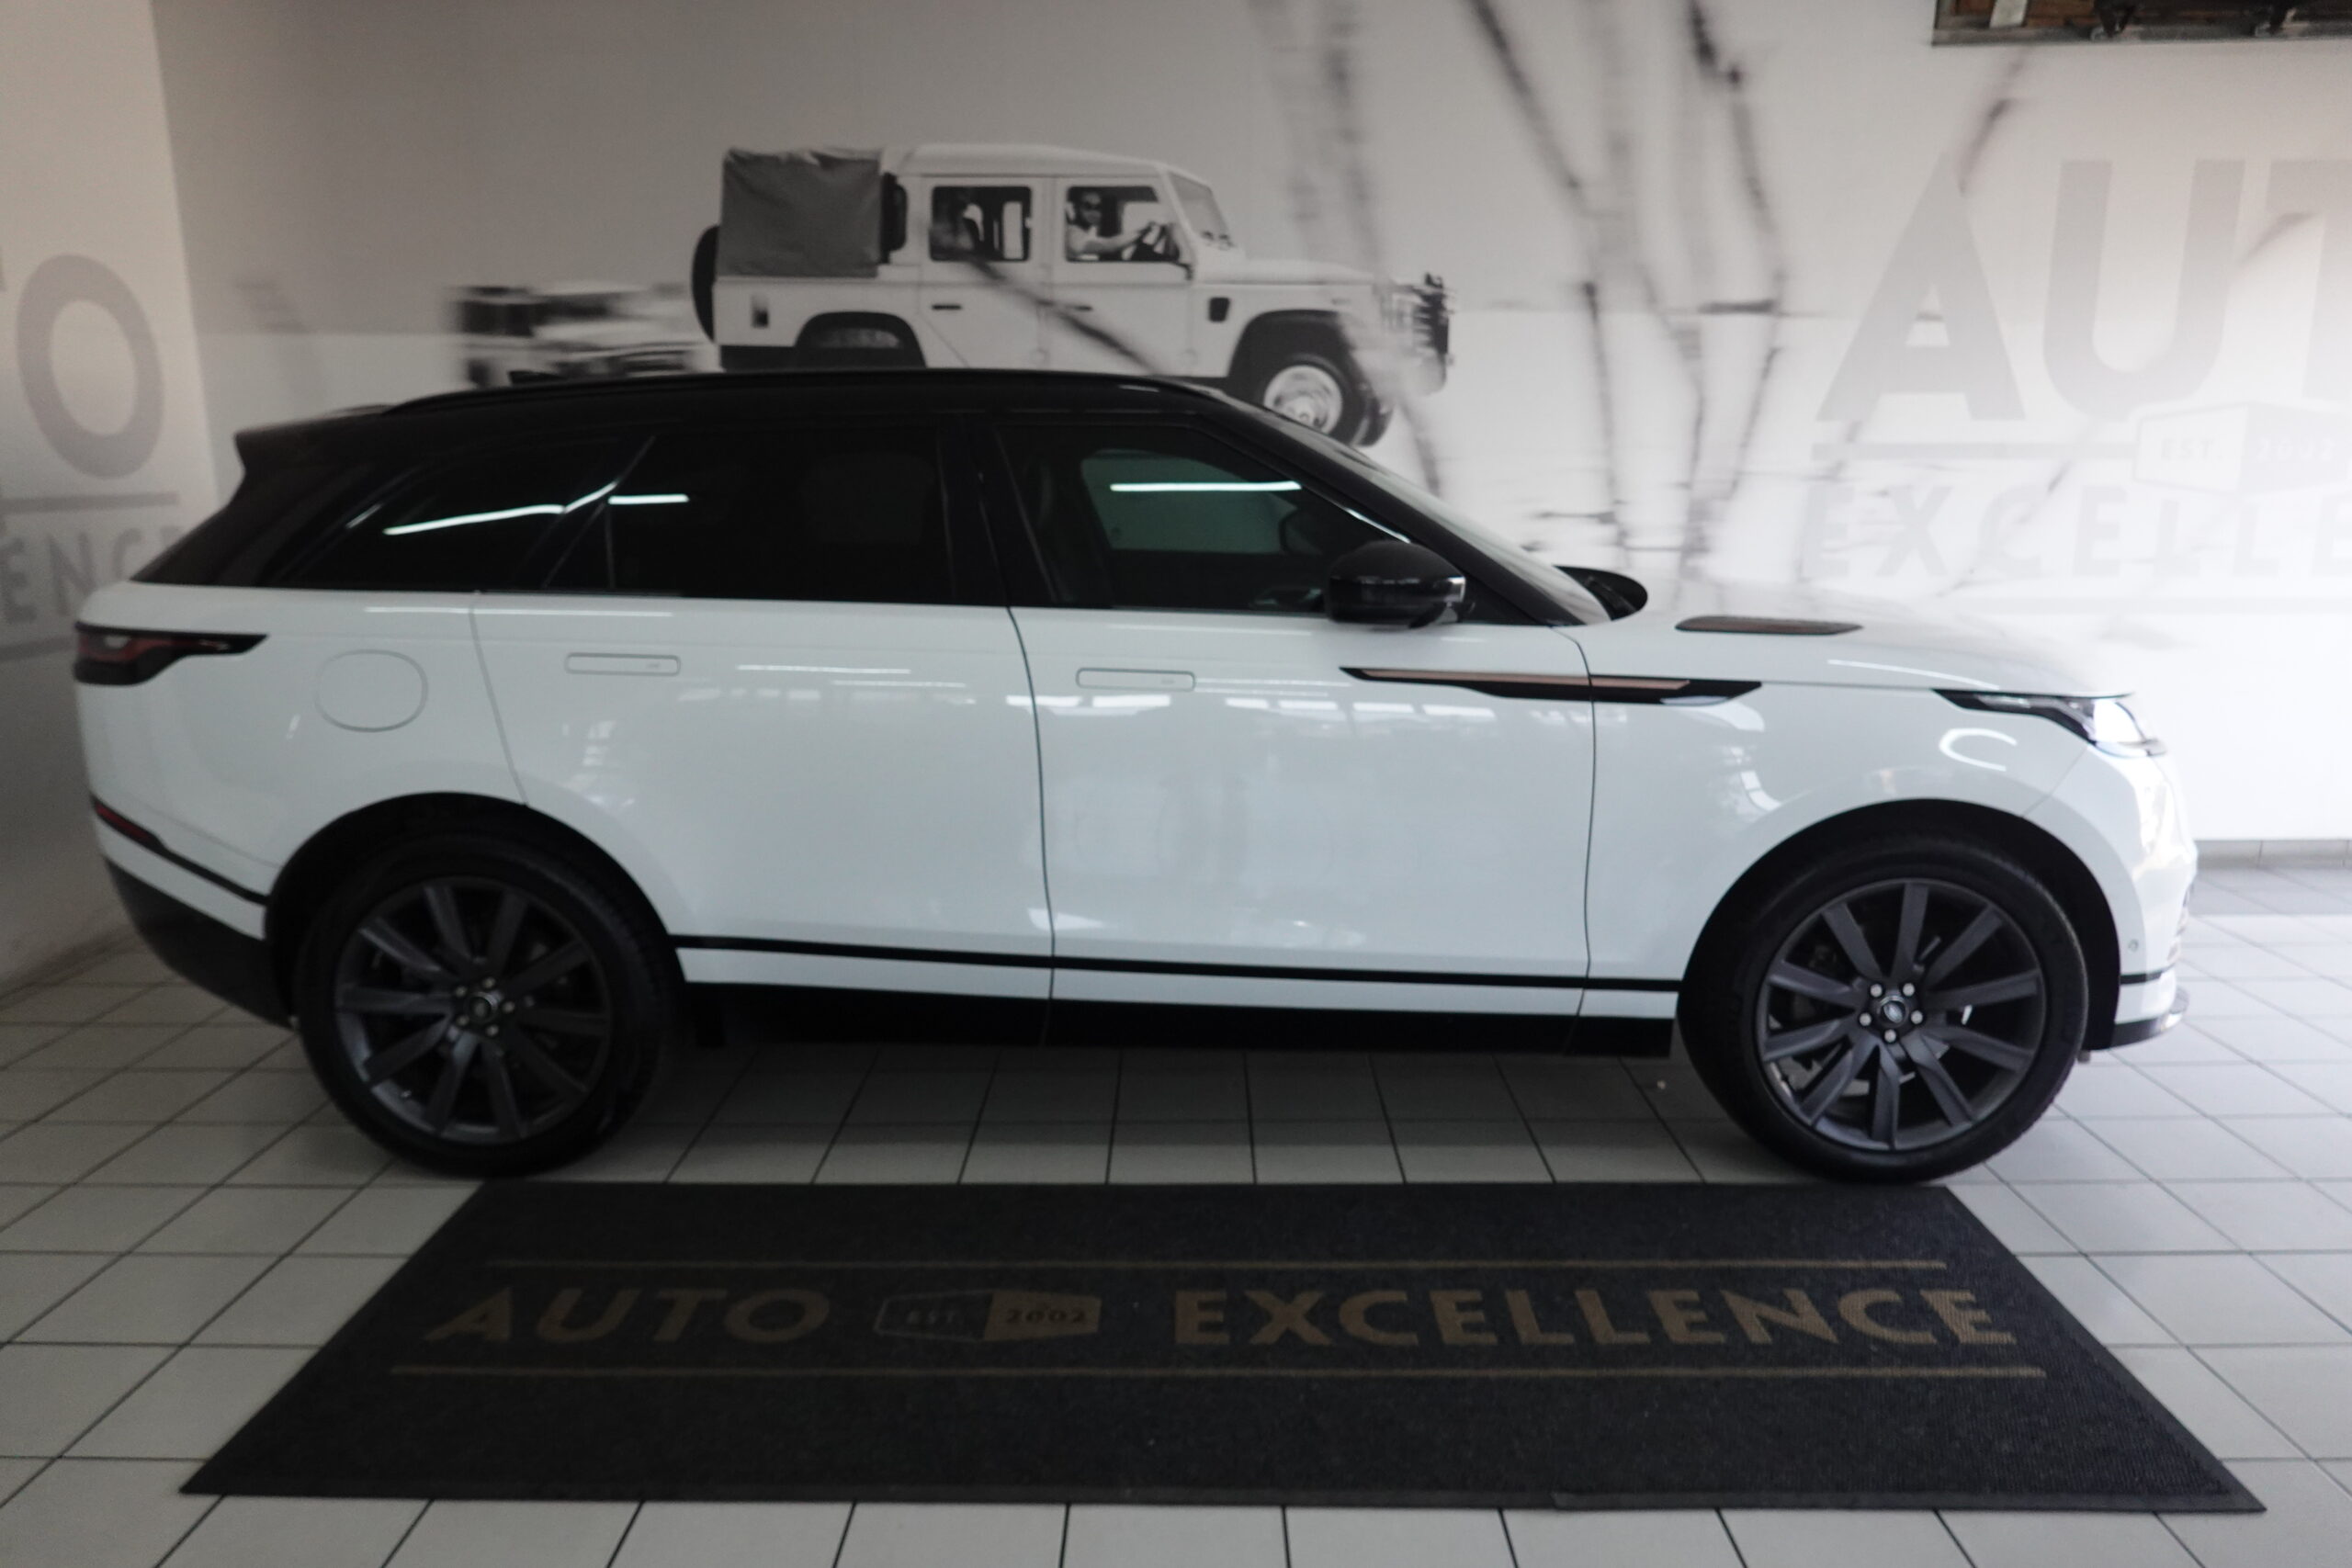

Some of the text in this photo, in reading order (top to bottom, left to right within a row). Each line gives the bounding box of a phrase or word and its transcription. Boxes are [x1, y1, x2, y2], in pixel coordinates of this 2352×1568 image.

[424, 1288, 831, 1342] AUTO
[1005, 1307, 1087, 1324] 2002
[1172, 1289, 2017, 1346] EXCELLENCE
